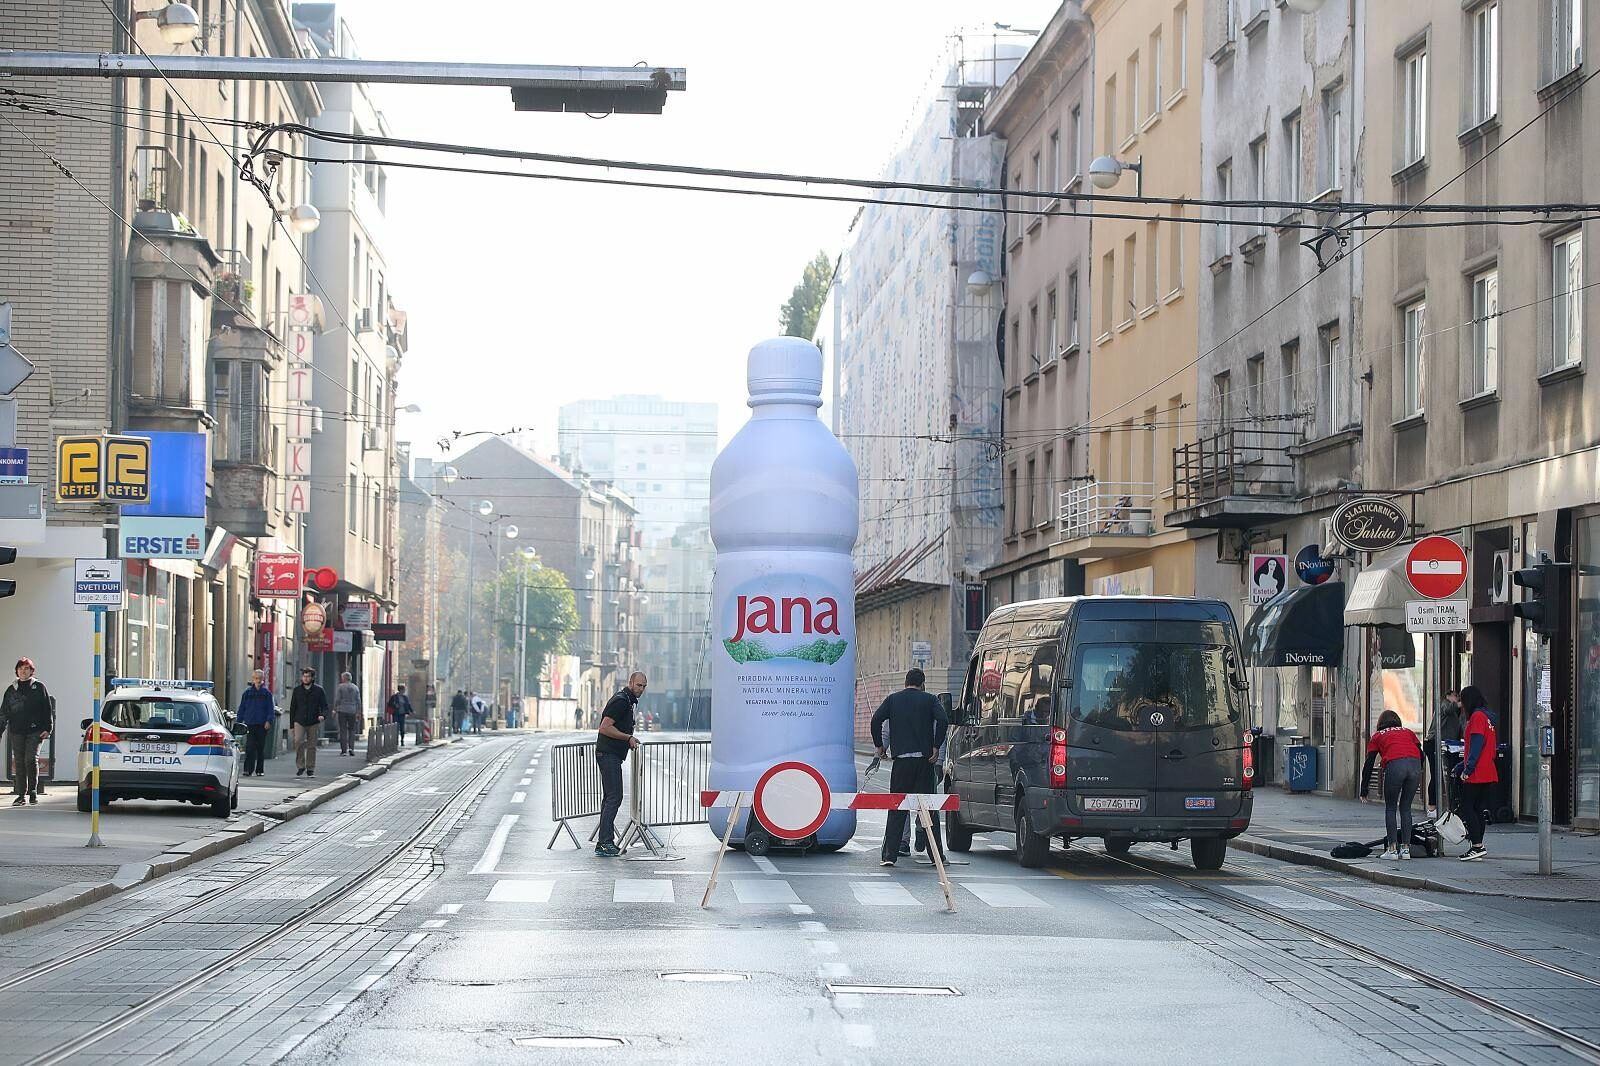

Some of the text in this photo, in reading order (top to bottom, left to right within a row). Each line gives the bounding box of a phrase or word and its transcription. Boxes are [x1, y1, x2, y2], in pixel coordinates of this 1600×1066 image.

[61, 485, 98, 496] RETEL
[107, 485, 146, 497] RETEL
[125, 536, 183, 555] ERSTE
[78, 594, 94, 602] linije
[1436, 605, 1457, 615] TRAM,
[1410, 617, 1424, 625] TAXI
[1432, 616, 1446, 625] BUS
[1447, 616, 1466, 625] ZET-a
[1285, 652, 1324, 663] iNovine
[141, 679, 183, 687] POLICIJA
[810, 687, 832, 695] WATER
[122, 755, 182, 765] POLICIJA
[1090, 799, 1102, 809] ZG
